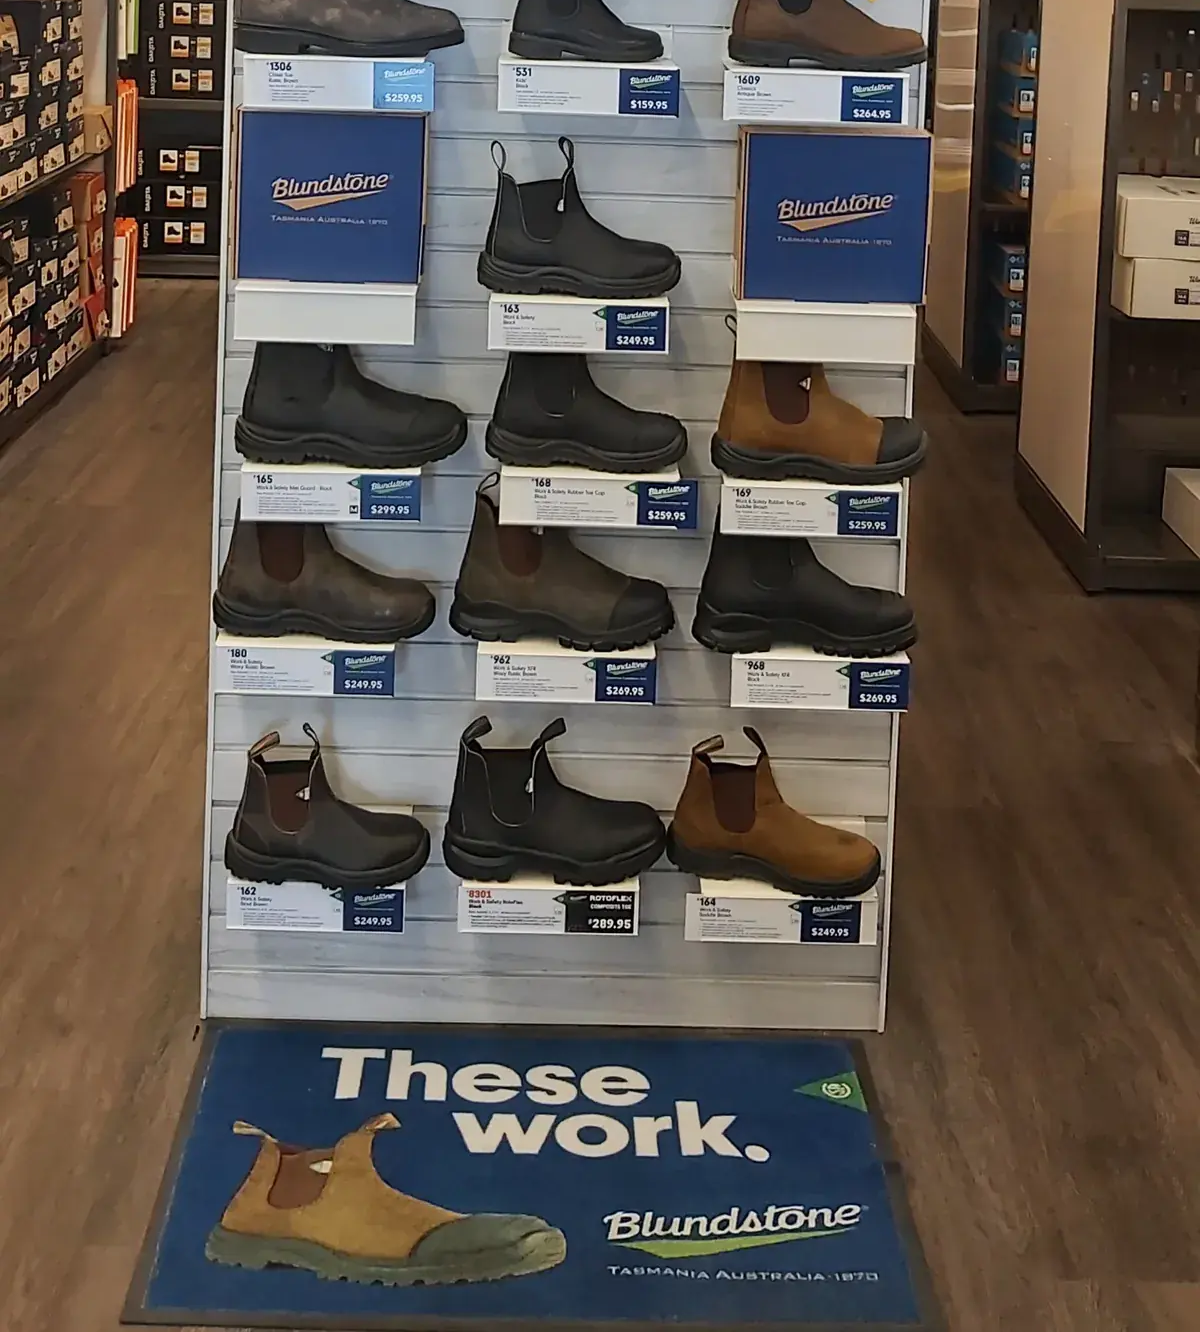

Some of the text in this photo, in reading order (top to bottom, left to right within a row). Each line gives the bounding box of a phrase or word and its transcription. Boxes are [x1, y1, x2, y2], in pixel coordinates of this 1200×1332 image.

[385, 94, 422, 102] $259.95
[631, 100, 668, 109] $159.95
[853, 109, 891, 118] $264.95
[272, 173, 389, 199] Blundstone
[777, 194, 894, 219] Blundstone
[617, 336, 655, 345] $249.95
[371, 505, 409, 514] $299.95
[648, 511, 685, 520] $259.95
[849, 521, 886, 530] $259.95
[345, 680, 382, 689] $249.95
[606, 686, 644, 696] $269.95
[860, 694, 897, 703] $269.95
[354, 917, 392, 926] $249.95
[812, 928, 849, 937] $249.95
[321, 1047, 651, 1106] These
[452, 1100, 770, 1163] work.
[603, 1204, 861, 1240] Blundstone
[608, 1266, 709, 1279] TASMANIA
